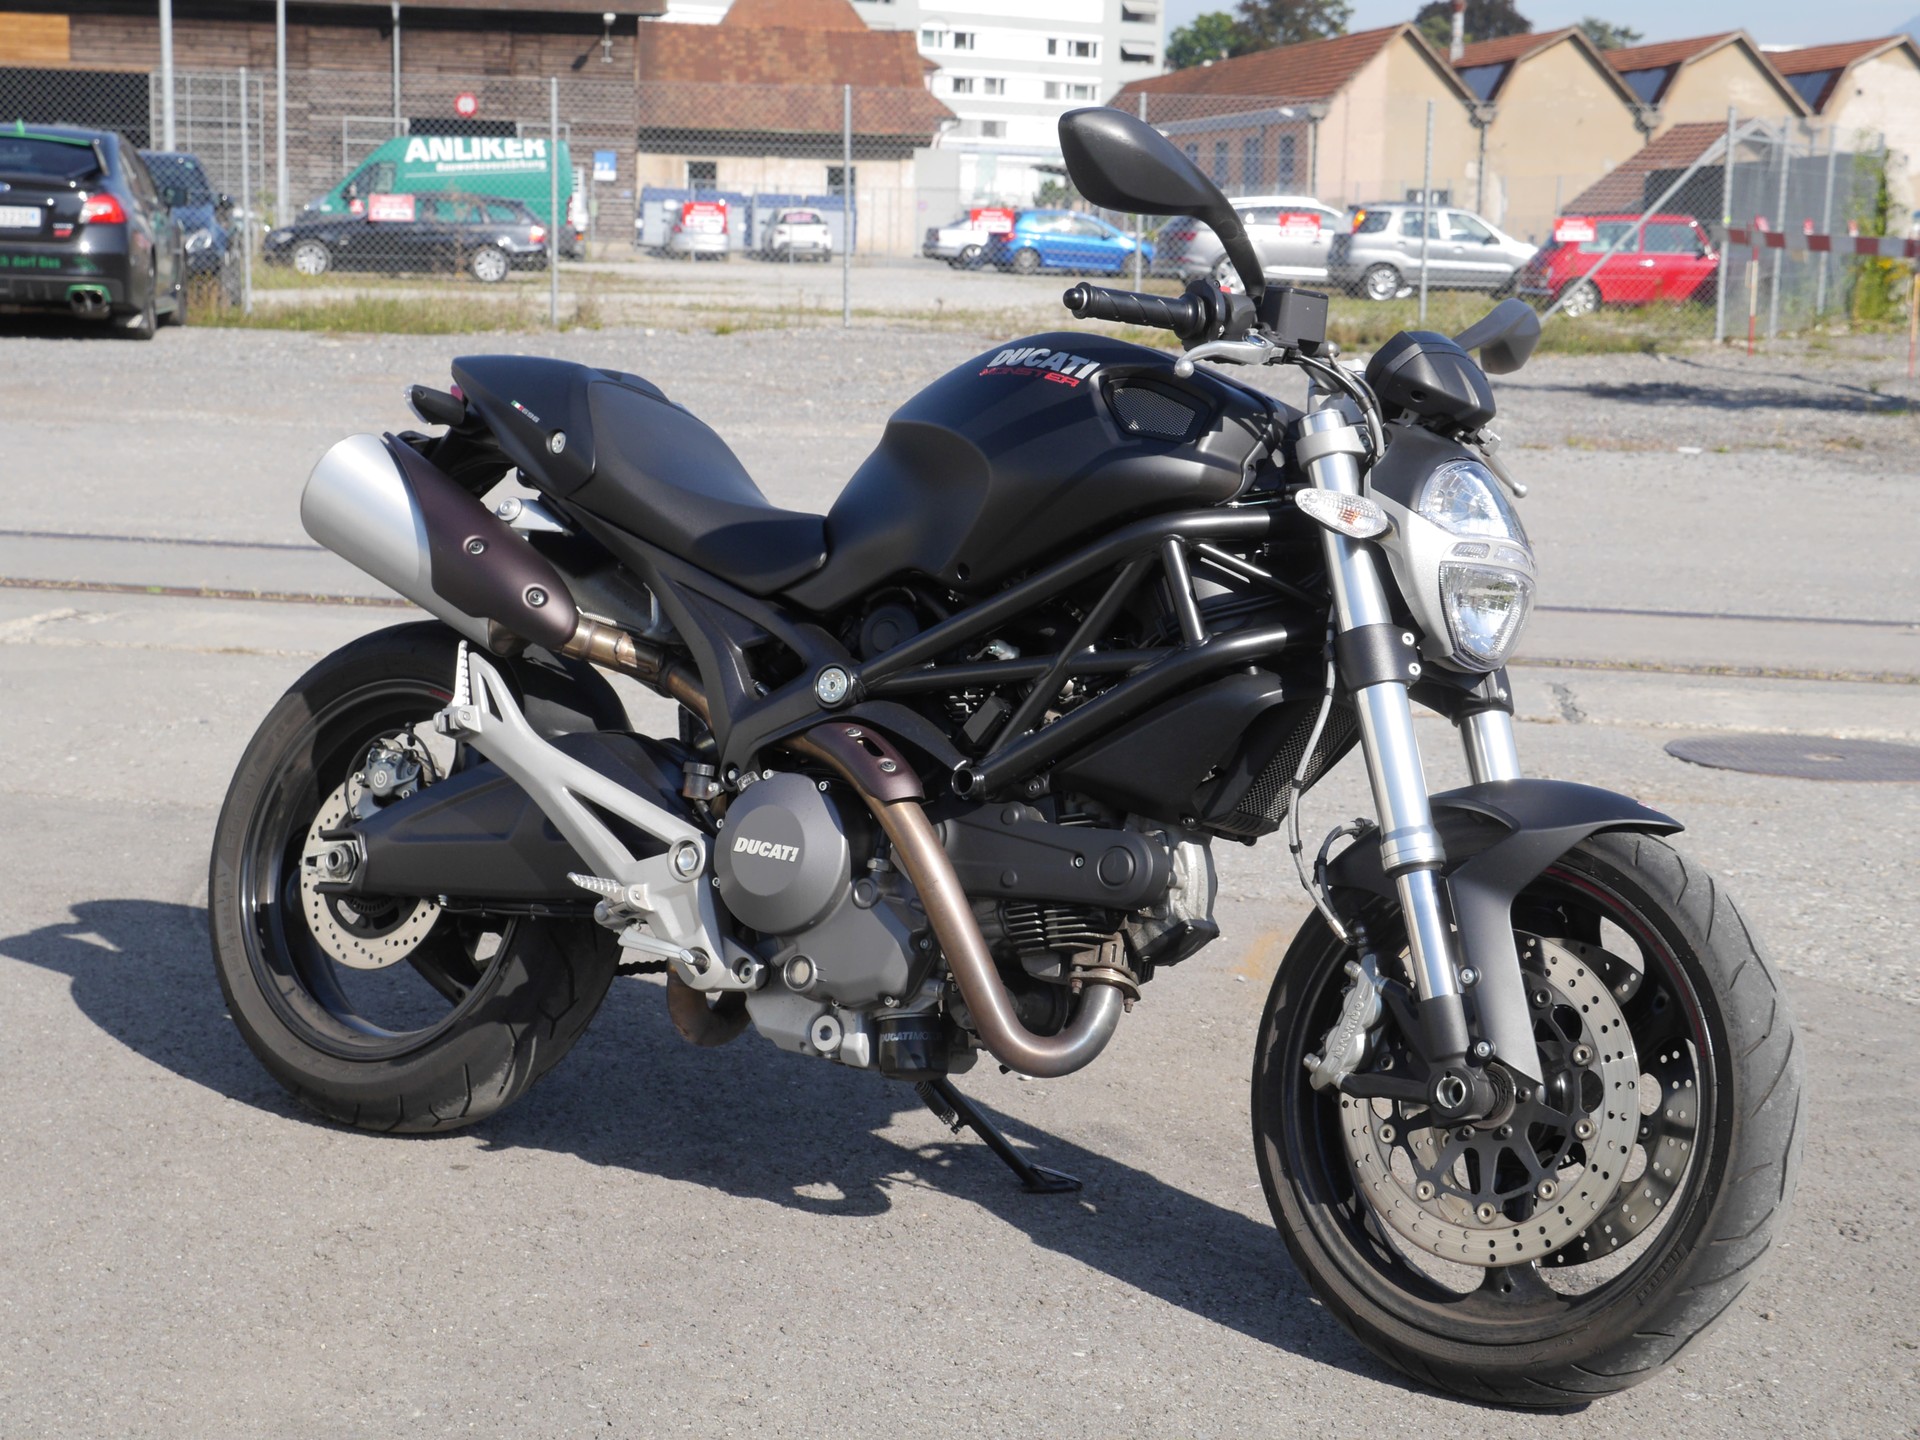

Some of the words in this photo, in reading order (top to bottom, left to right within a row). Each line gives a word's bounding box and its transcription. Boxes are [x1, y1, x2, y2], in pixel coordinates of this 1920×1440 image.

[404, 137, 547, 163] ANLIKER
[987, 348, 1100, 380] DUCATI
[979, 367, 1080, 388] MONSTER
[733, 837, 800, 862] DUCATI
